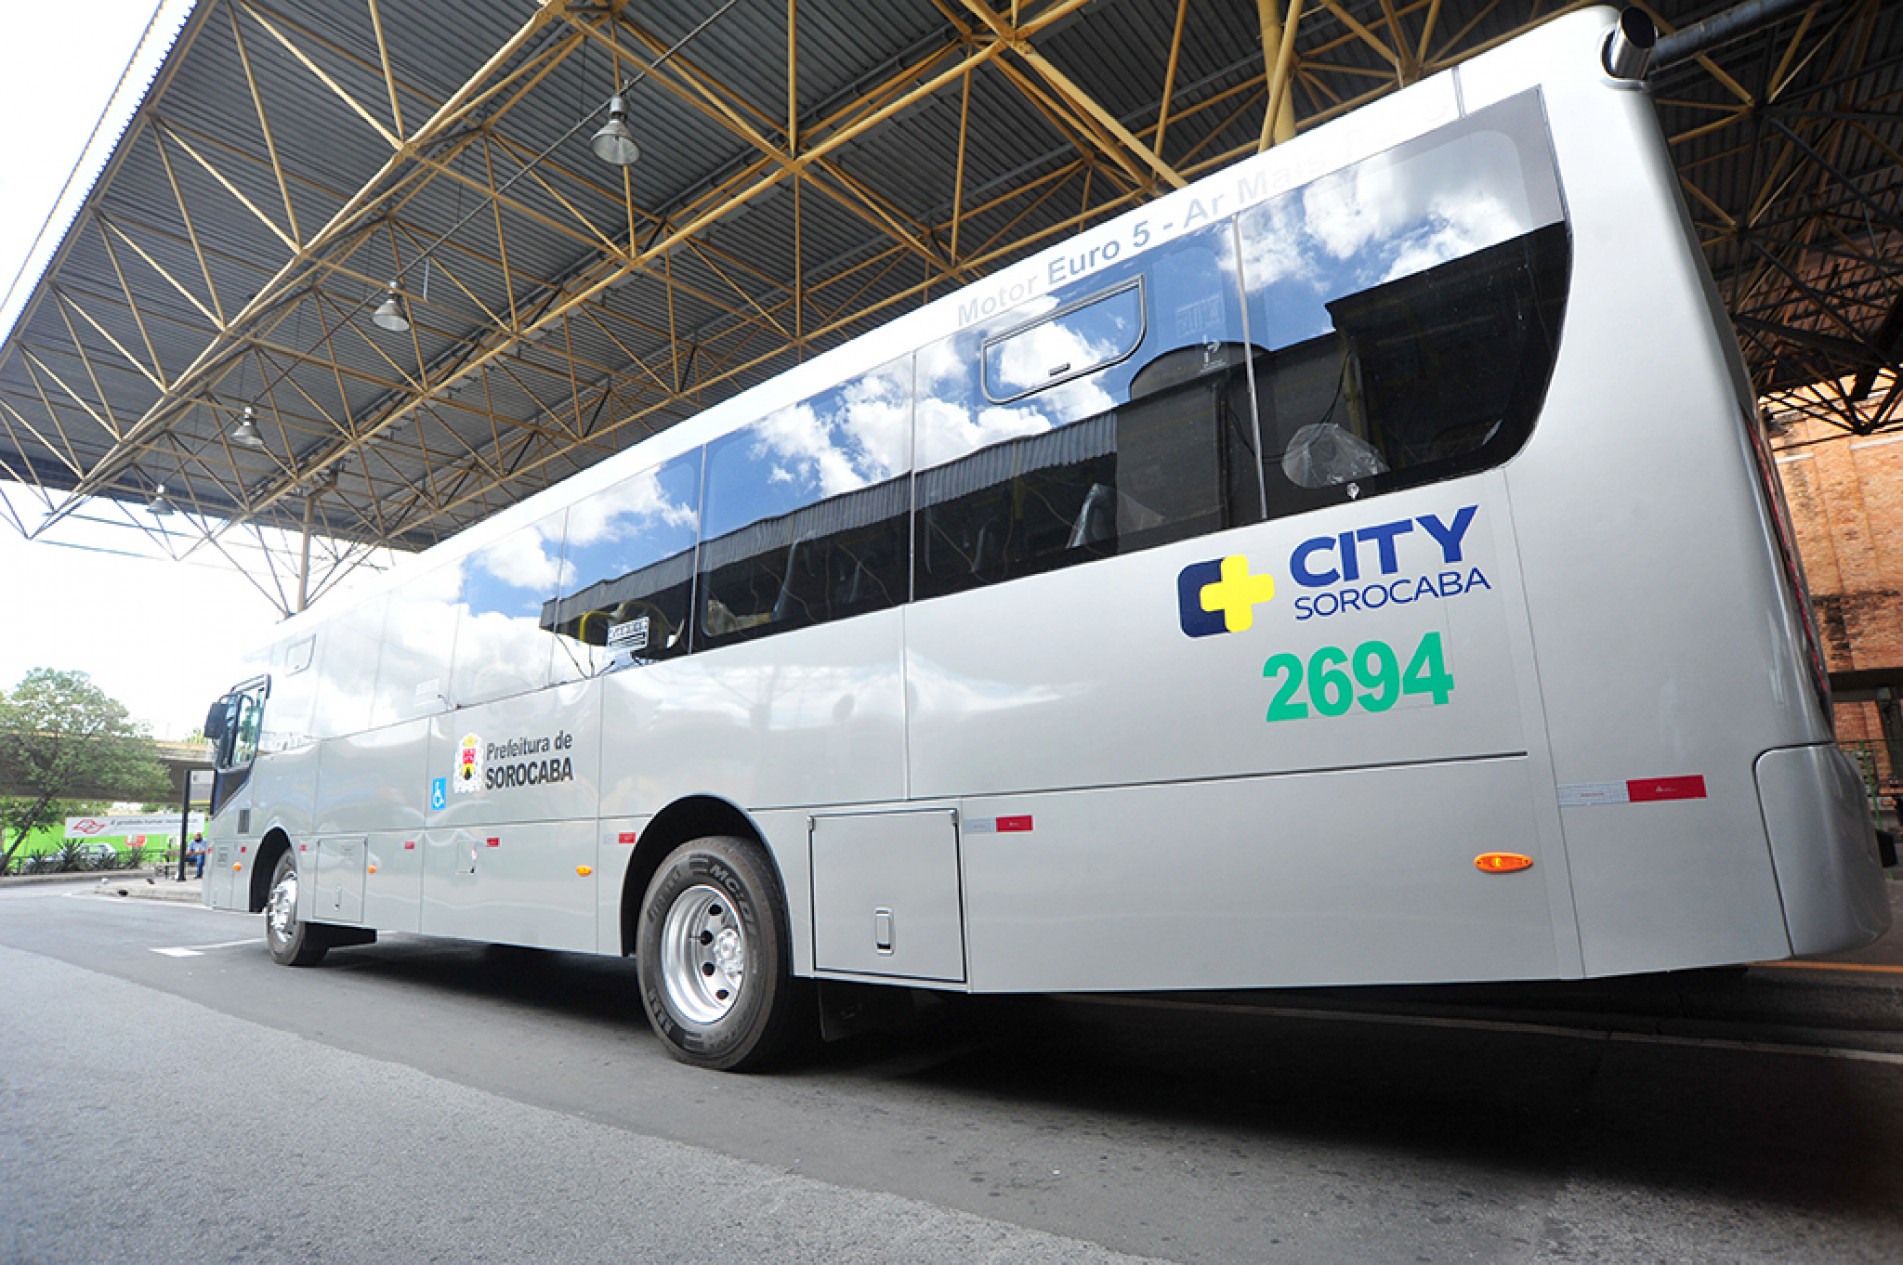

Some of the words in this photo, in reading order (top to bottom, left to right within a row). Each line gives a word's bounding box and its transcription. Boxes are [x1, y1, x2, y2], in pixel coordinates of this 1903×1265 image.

[957, 274, 1040, 327] Motor
[1047, 237, 1121, 286] Euro
[1132, 220, 1153, 250] 5
[1183, 189, 1227, 229] Ar
[1237, 149, 1328, 205] Mais
[1289, 504, 1479, 588] CITY
[1295, 567, 1492, 621] SOROCABA
[1262, 631, 1455, 723] 2694
[485, 757, 574, 790] SOROCABA
[486, 736, 550, 761] Prefeitura
[554, 730, 573, 751] de
